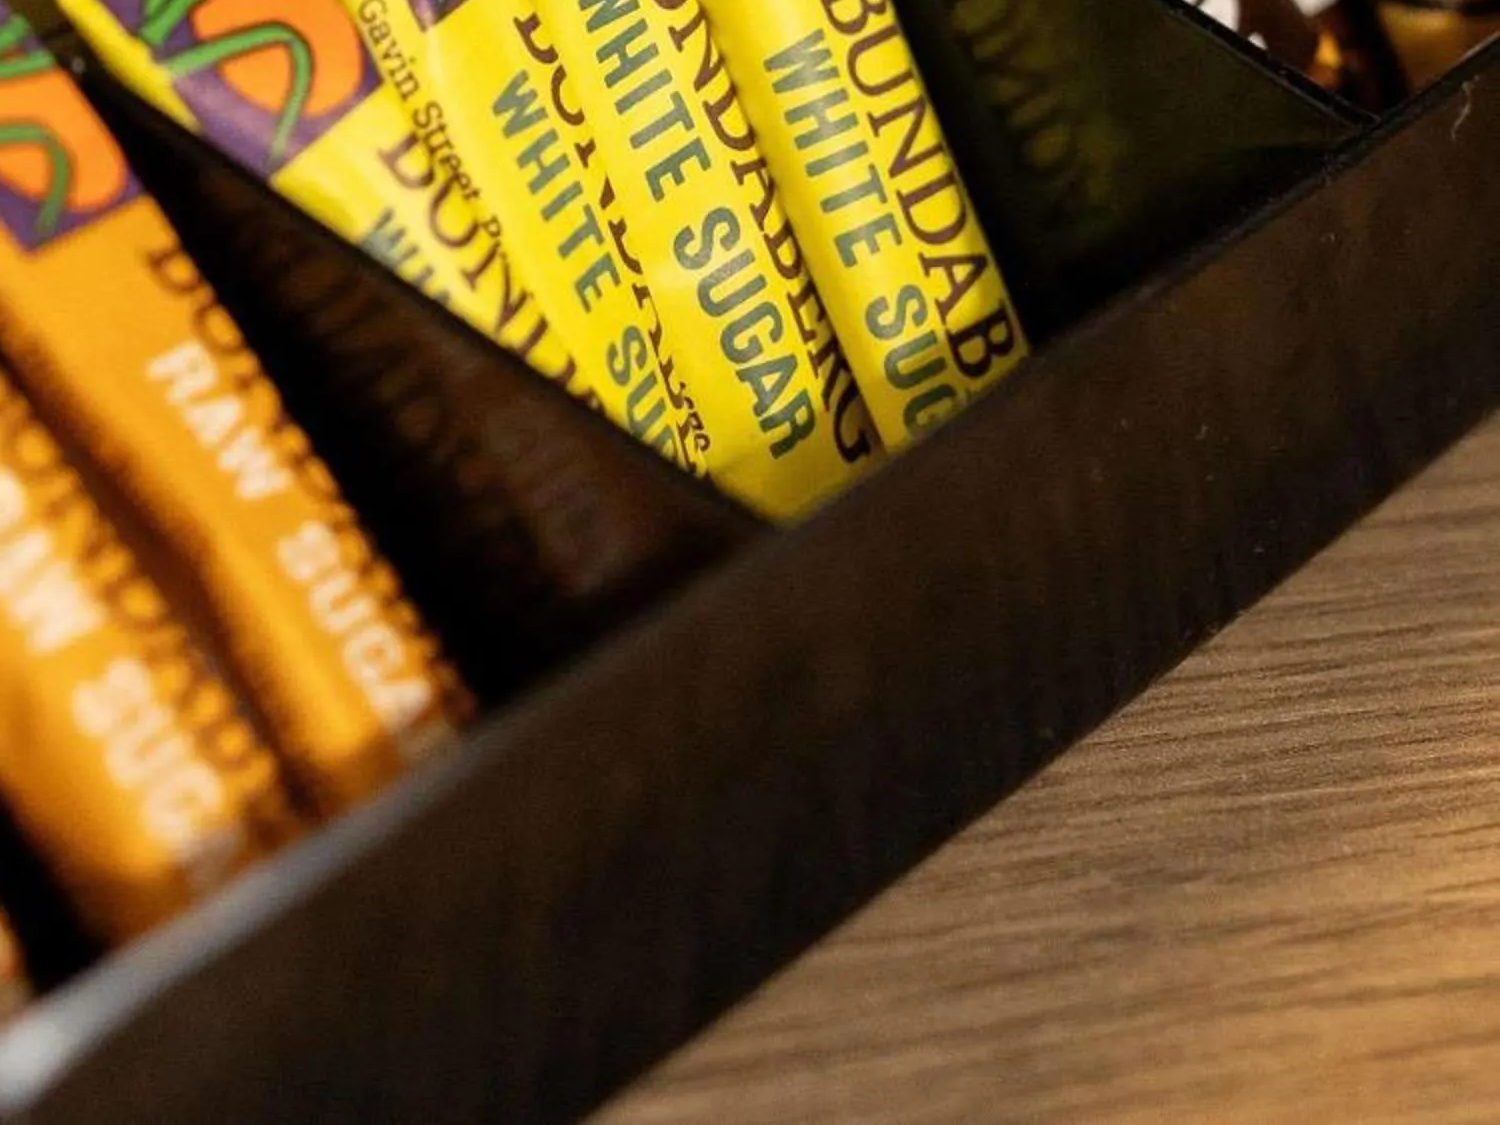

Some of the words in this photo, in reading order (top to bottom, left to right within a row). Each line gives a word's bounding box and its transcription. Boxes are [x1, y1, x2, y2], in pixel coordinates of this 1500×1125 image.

[412, 99, 481, 202] Street
[491, 69, 622, 314] WHITE
[763, 28, 903, 269] WHITE
[148, 338, 293, 502] RAW
[673, 206, 817, 460] SUGAR
[71, 656, 235, 857] SUG
